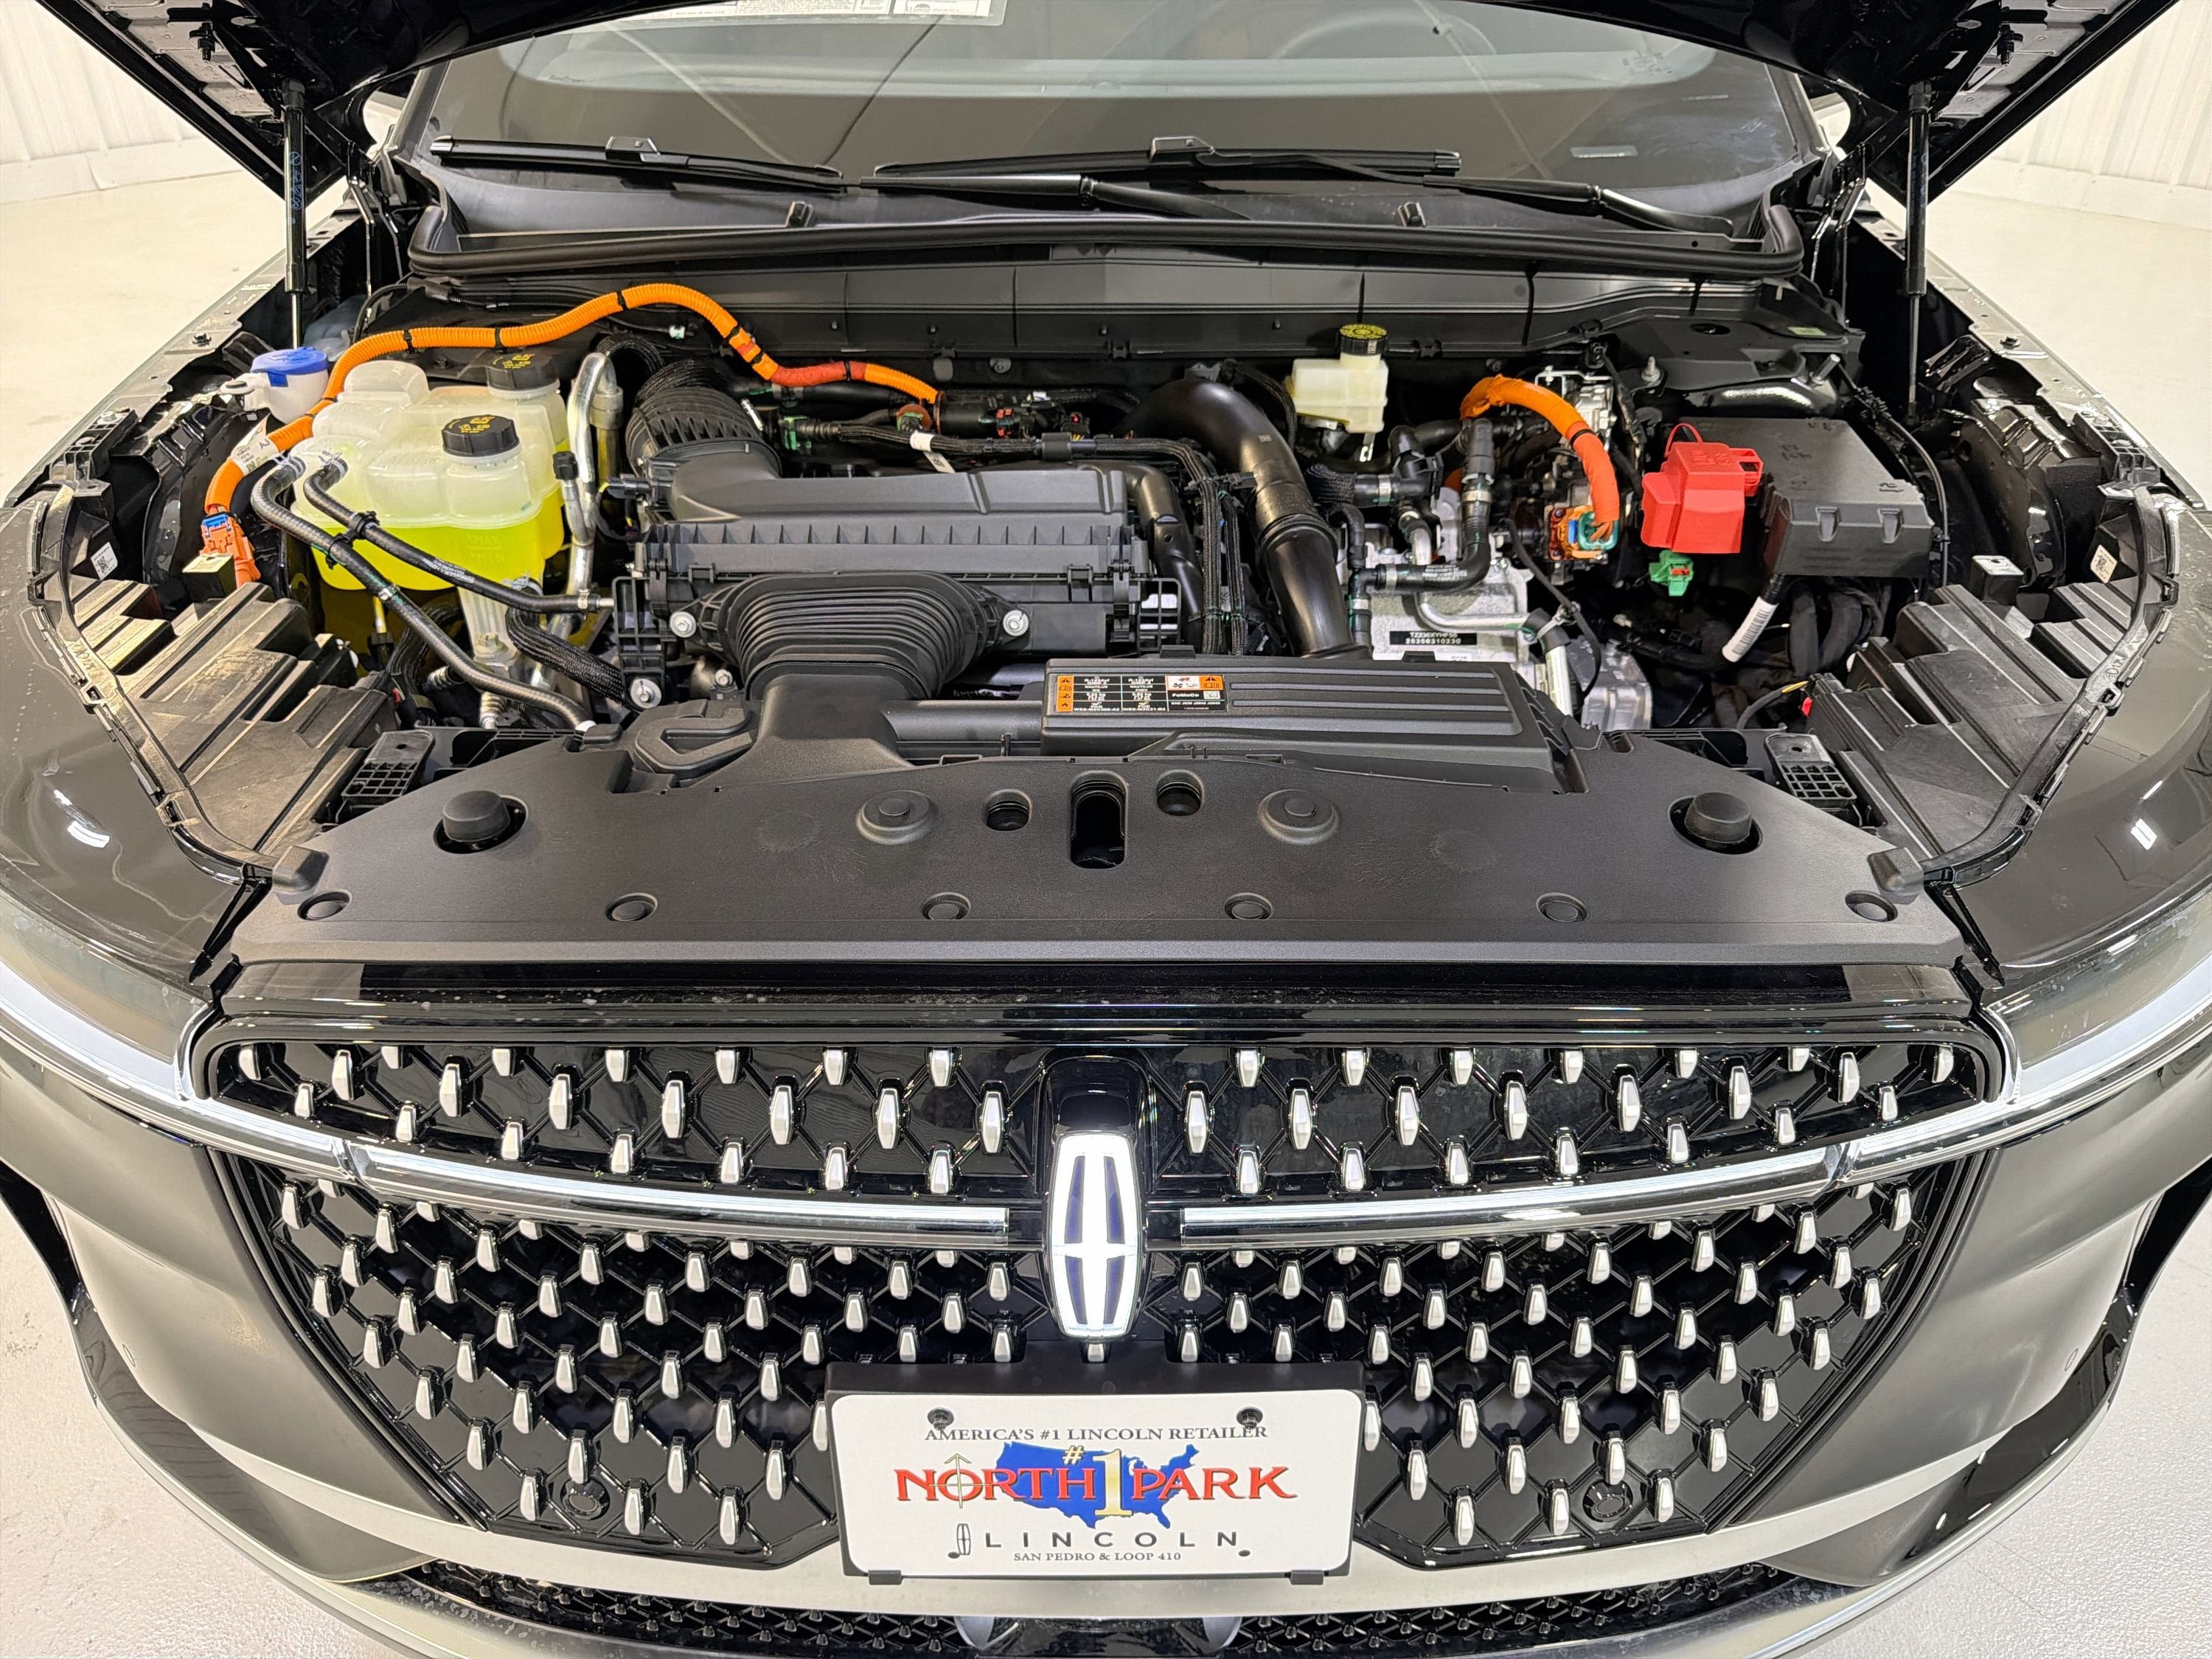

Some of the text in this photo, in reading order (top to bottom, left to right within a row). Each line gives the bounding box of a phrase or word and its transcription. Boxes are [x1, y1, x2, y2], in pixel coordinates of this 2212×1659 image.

[925, 1426, 1269, 1441] AMERICA'S #1 LINCOLN RETAILER
[894, 1466, 1298, 1501] NORTH PARK
[985, 1531, 1237, 1548] LINCOLN
[1013, 1551, 1181, 1561] SAN PEDRO & LOOP 410
